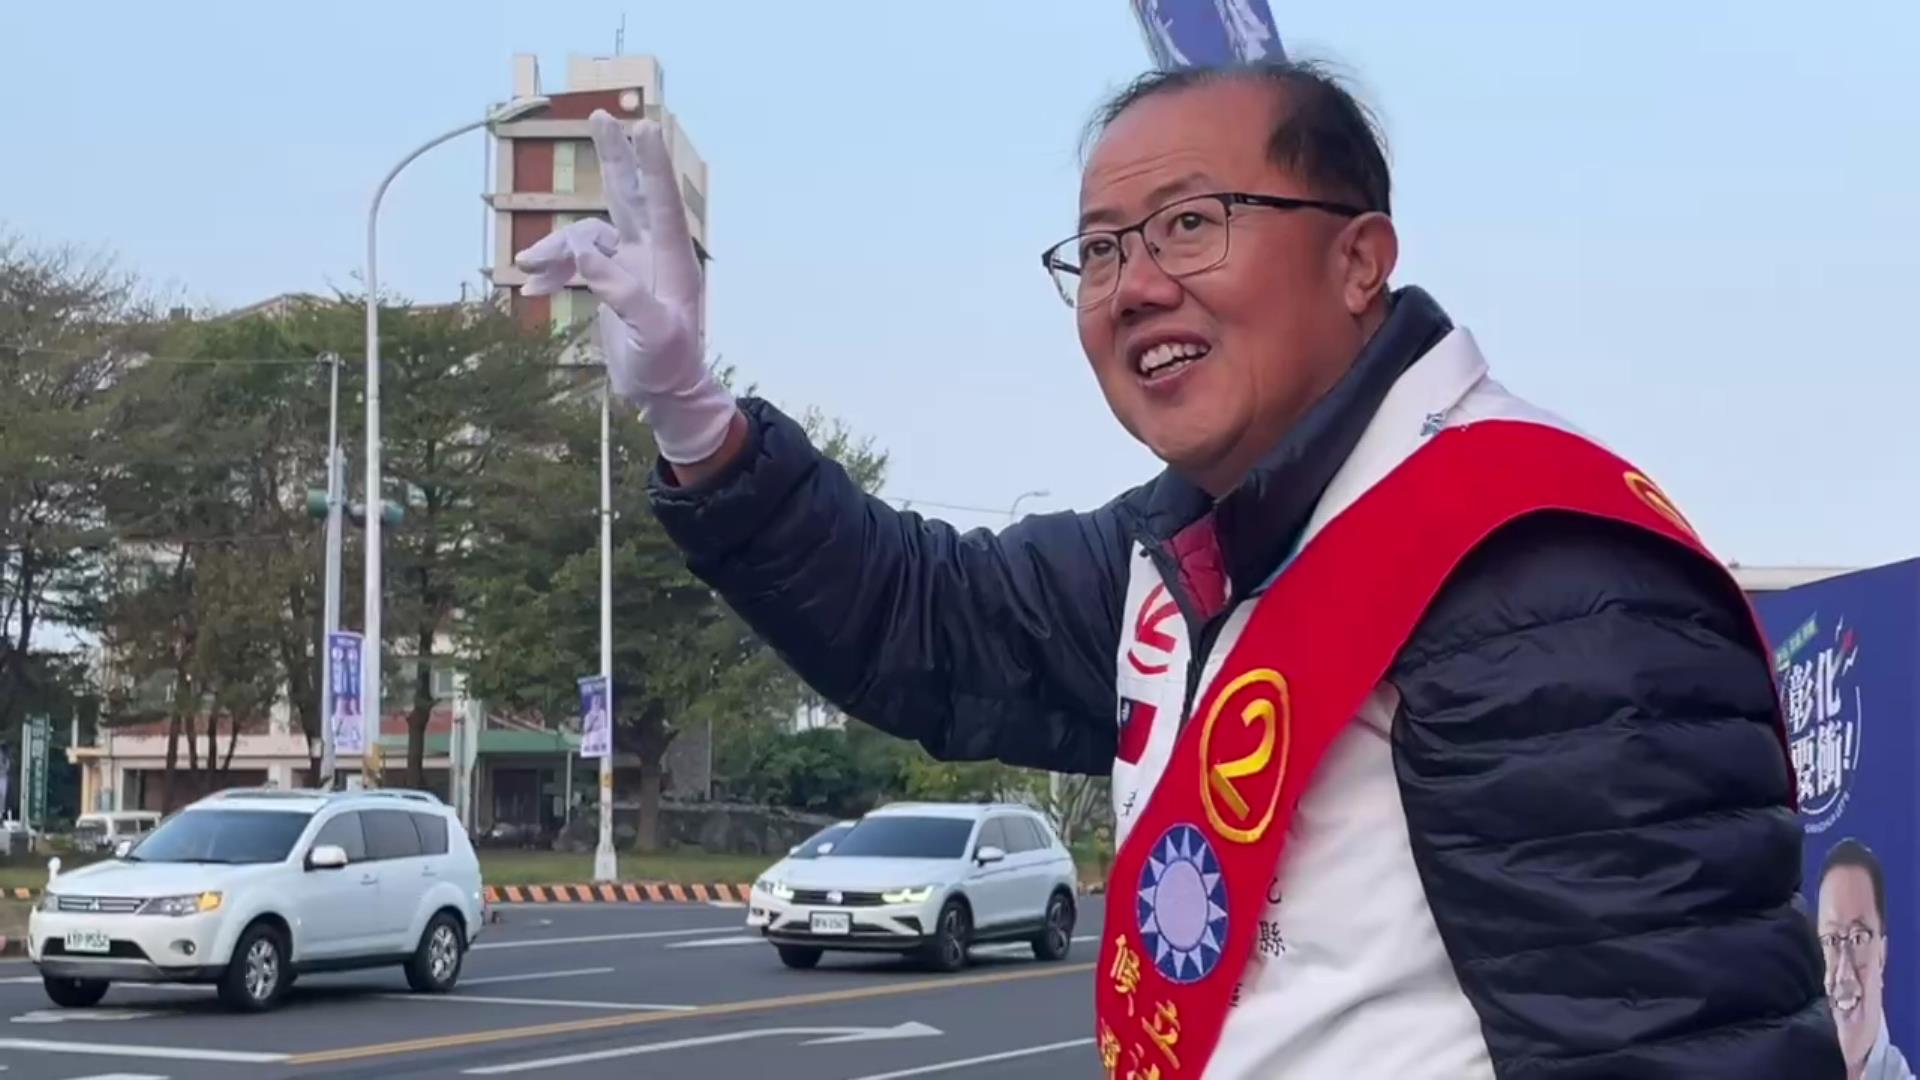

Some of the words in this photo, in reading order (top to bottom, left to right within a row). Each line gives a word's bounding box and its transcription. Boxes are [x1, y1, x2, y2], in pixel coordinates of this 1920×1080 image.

[1788, 647, 1842, 734] 彰化
[1211, 697, 1276, 822] 2
[1791, 720, 1854, 803] 要衝!
